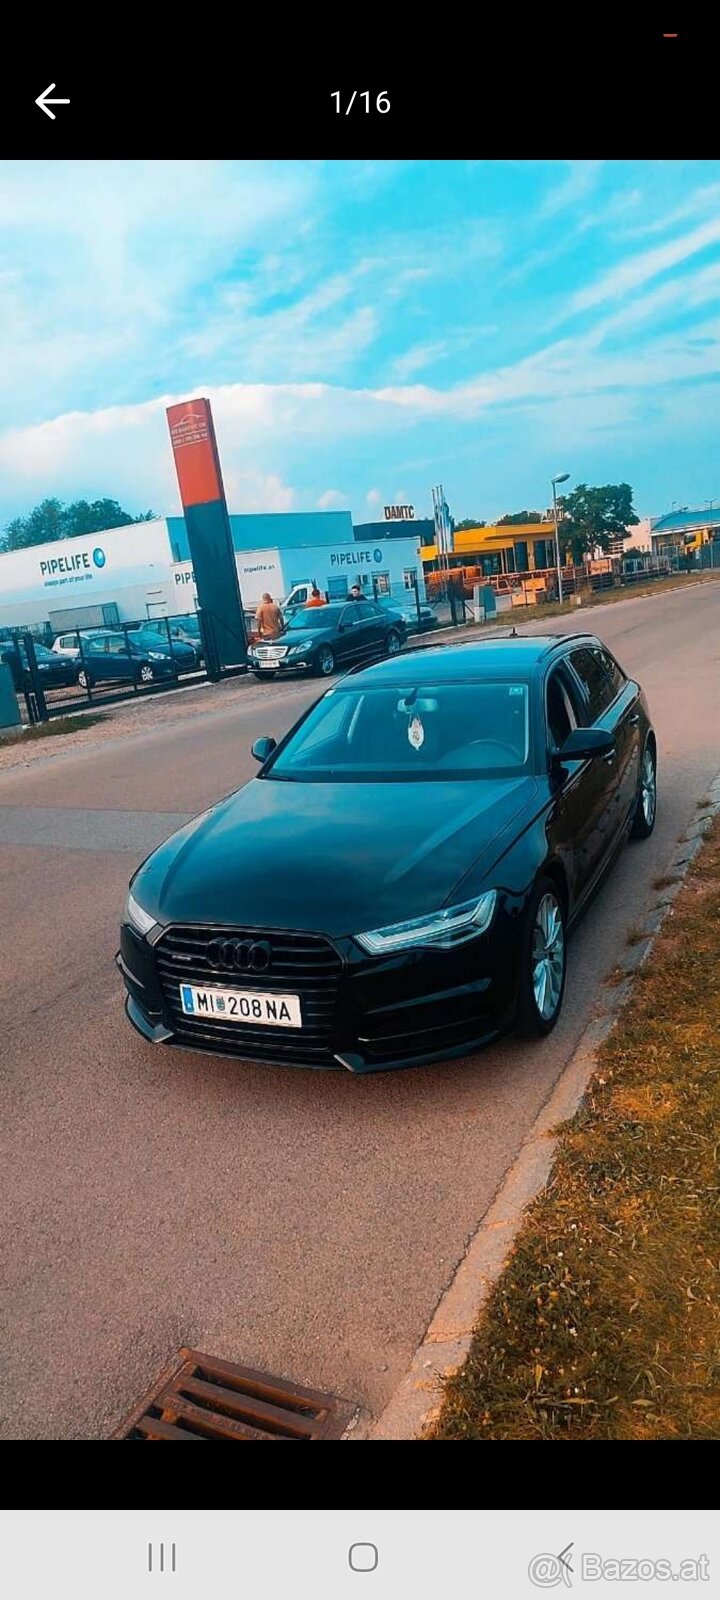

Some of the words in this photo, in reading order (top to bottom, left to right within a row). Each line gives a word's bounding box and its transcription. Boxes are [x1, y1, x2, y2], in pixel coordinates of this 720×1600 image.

[40, 553, 90, 576] PIPELIFE
[330, 551, 371, 566] PIPELIFE
[197, 992, 215, 1012] MI
[228, 997, 262, 1018] 208
